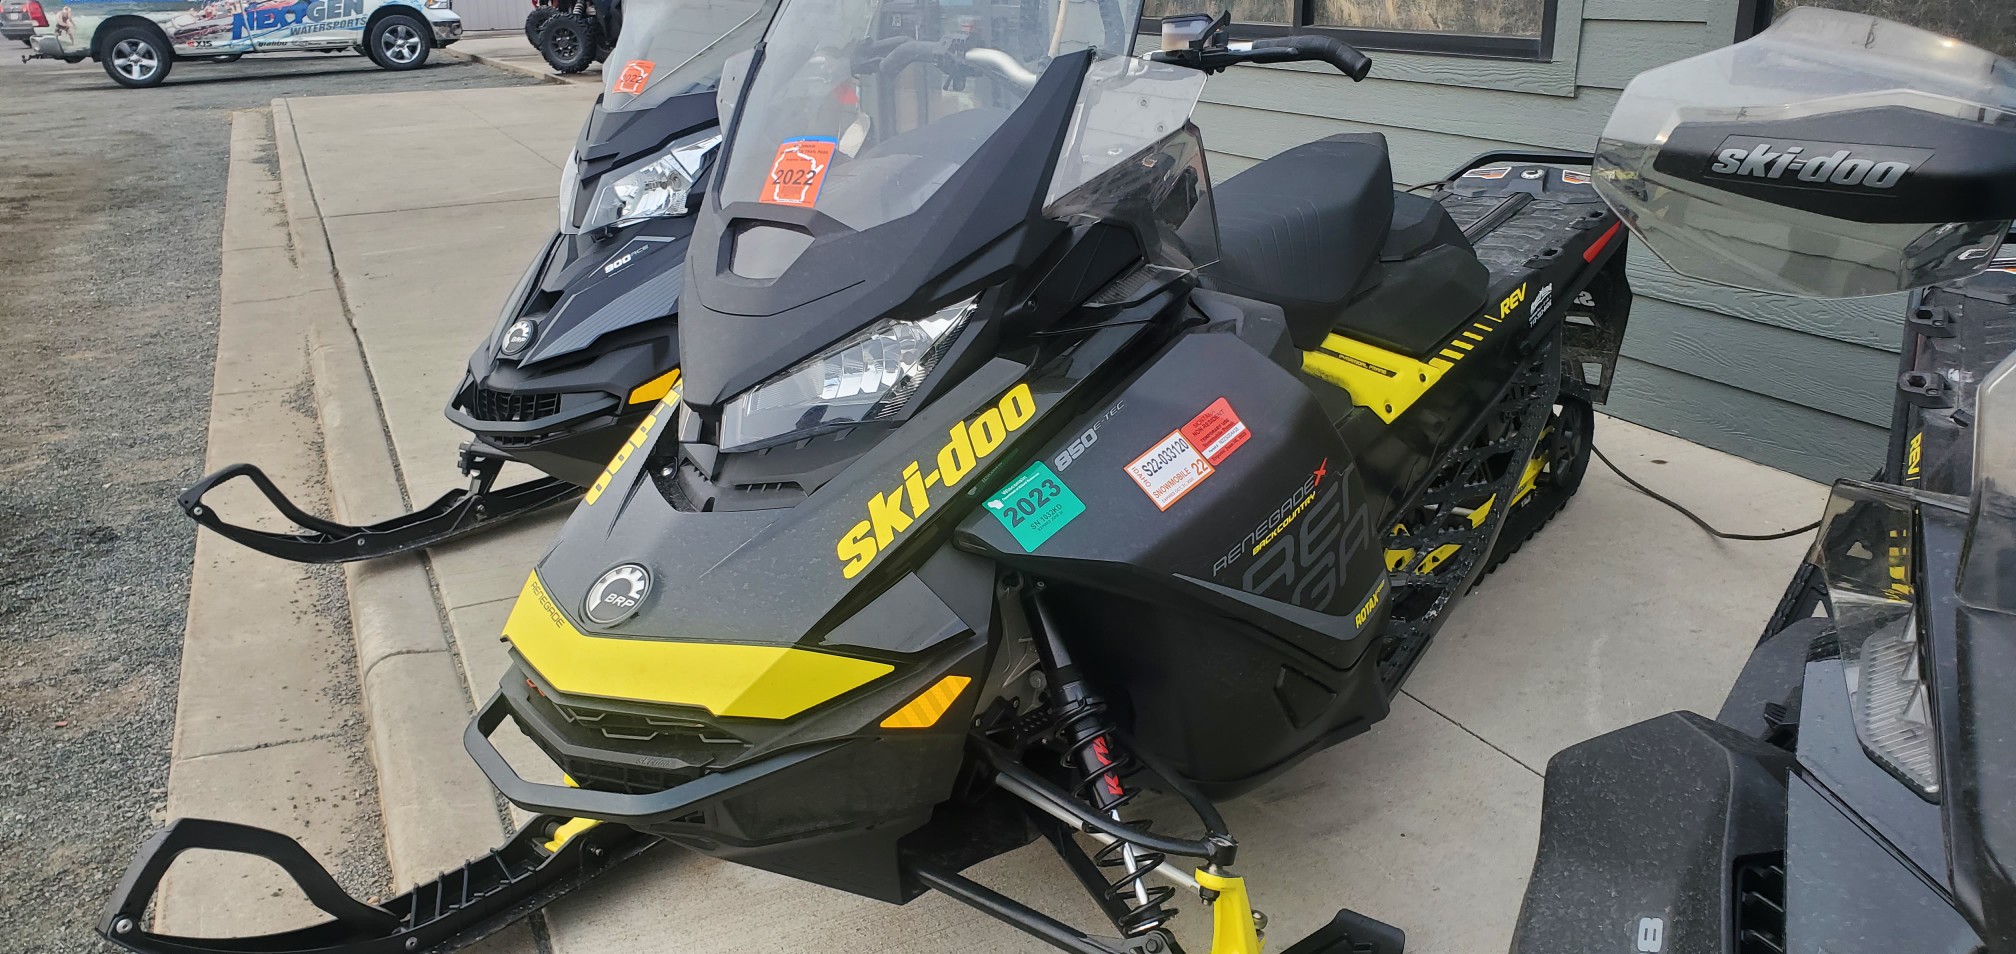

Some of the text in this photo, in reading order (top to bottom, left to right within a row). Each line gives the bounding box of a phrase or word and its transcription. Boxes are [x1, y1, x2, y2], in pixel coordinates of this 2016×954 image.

[290, 15, 368, 37] WATERSPORTS
[772, 169, 817, 186] 2022
[1711, 143, 1911, 190] ski-doo
[1500, 282, 1527, 320] REV
[1054, 399, 1126, 472] 850 E-TEC
[1192, 409, 1216, 428] MONTANA
[1192, 408, 1225, 437] NON-RESIDENT
[1141, 437, 1190, 477] S22-033120
[1907, 431, 1923, 475] REV
[837, 383, 1036, 579] ski-doo
[1001, 475, 1028, 495] Wisconsin
[1131, 466, 1152, 488] IDAHO
[1152, 458, 1209, 499] SNOWMOBILE 22
[1003, 478, 1062, 529] 2023
[1030, 503, 1063, 530] SN 1032KD
[1252, 490, 1316, 556] BACKCOUNTRY
[1212, 474, 1315, 577] RENEGADE
[530, 581, 566, 629] RENEGADE
[604, 592, 636, 608] BRP
[1354, 591, 1379, 629] ROTAX
